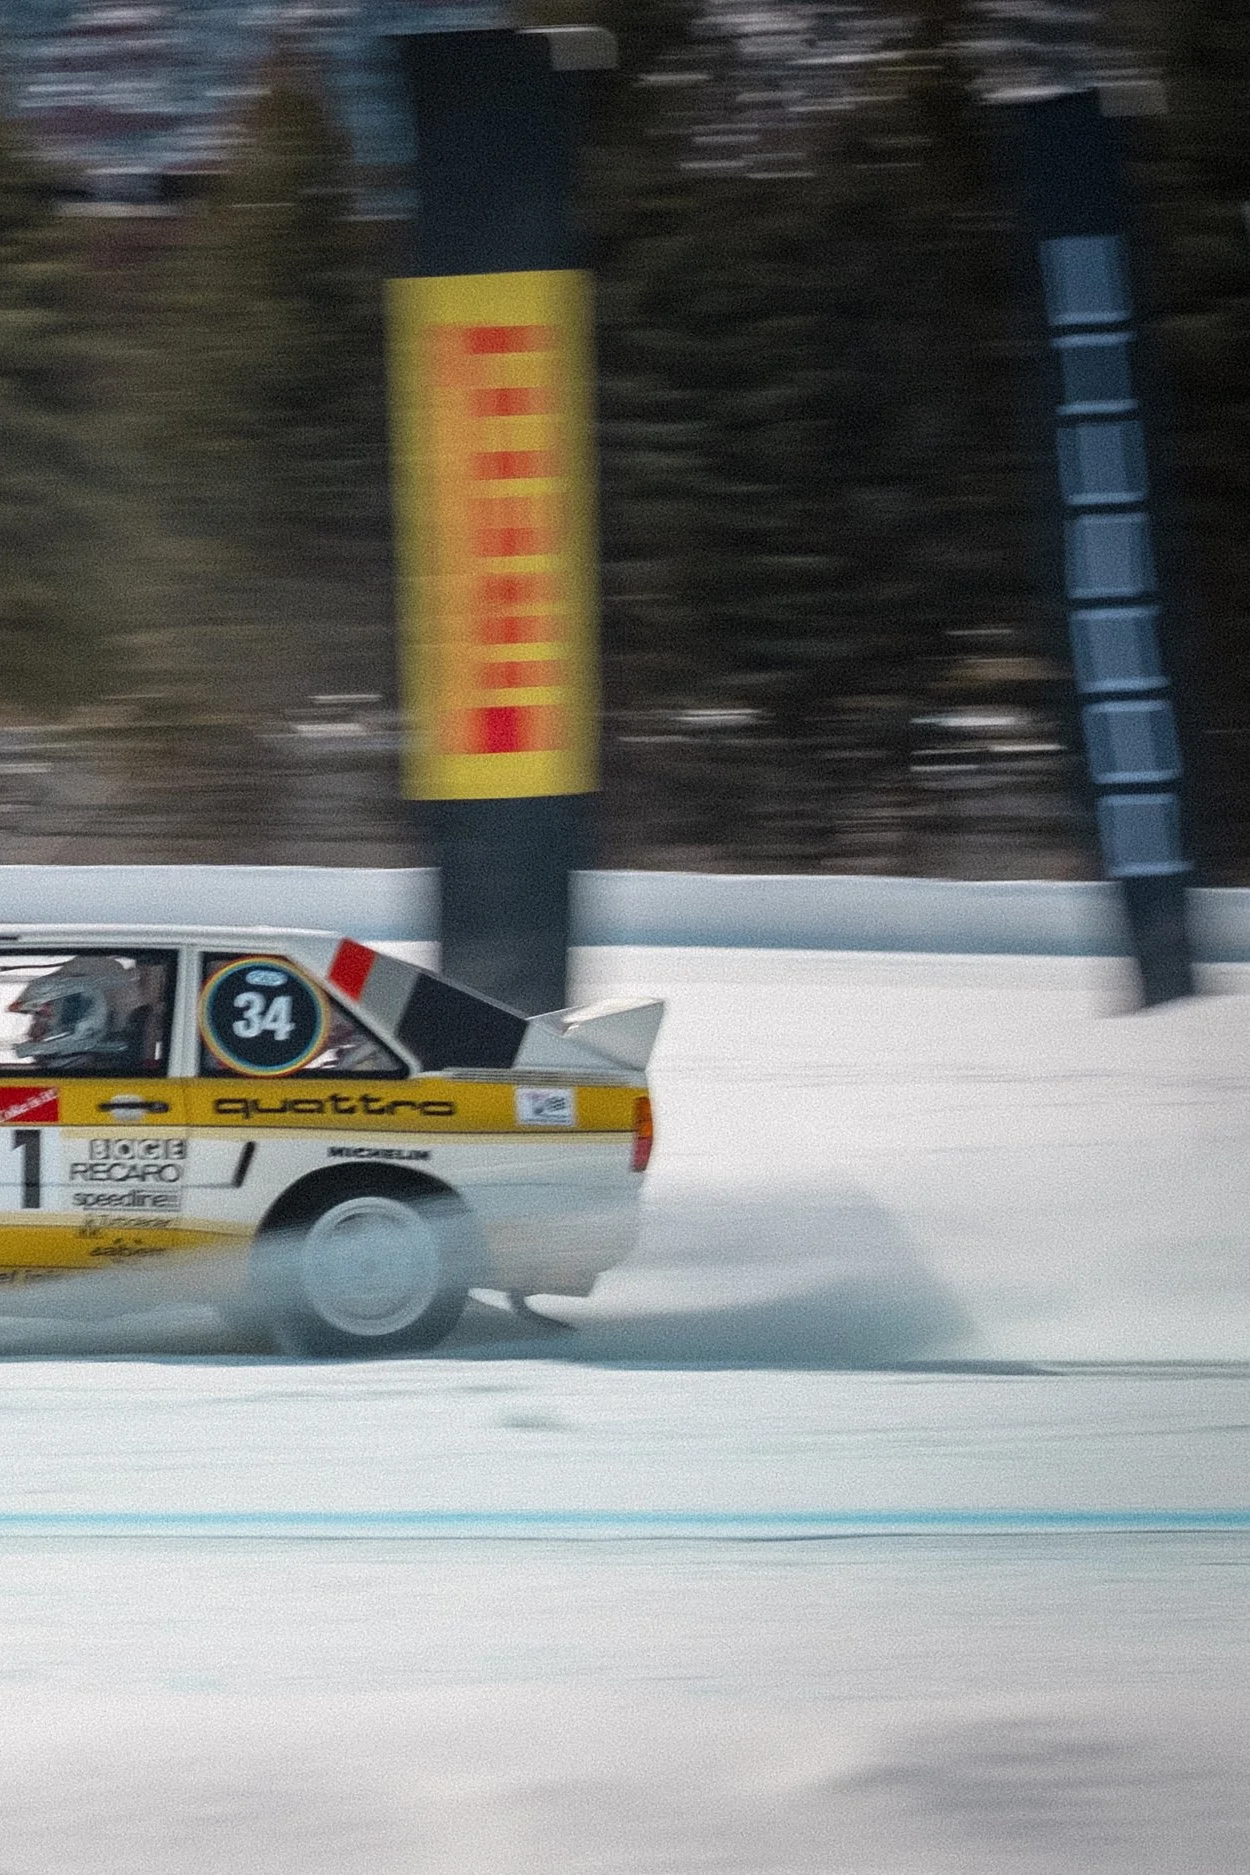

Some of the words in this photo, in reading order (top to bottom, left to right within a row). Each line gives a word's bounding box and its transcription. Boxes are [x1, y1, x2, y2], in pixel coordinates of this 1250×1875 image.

[233, 991, 296, 1041] 34
[213, 1093, 456, 1119] quattro
[89, 1138, 187, 1160] BOGE
[327, 1145, 431, 1161] MICHELIN
[10, 1129, 42, 1209] 1
[69, 1162, 184, 1183] RECARO
